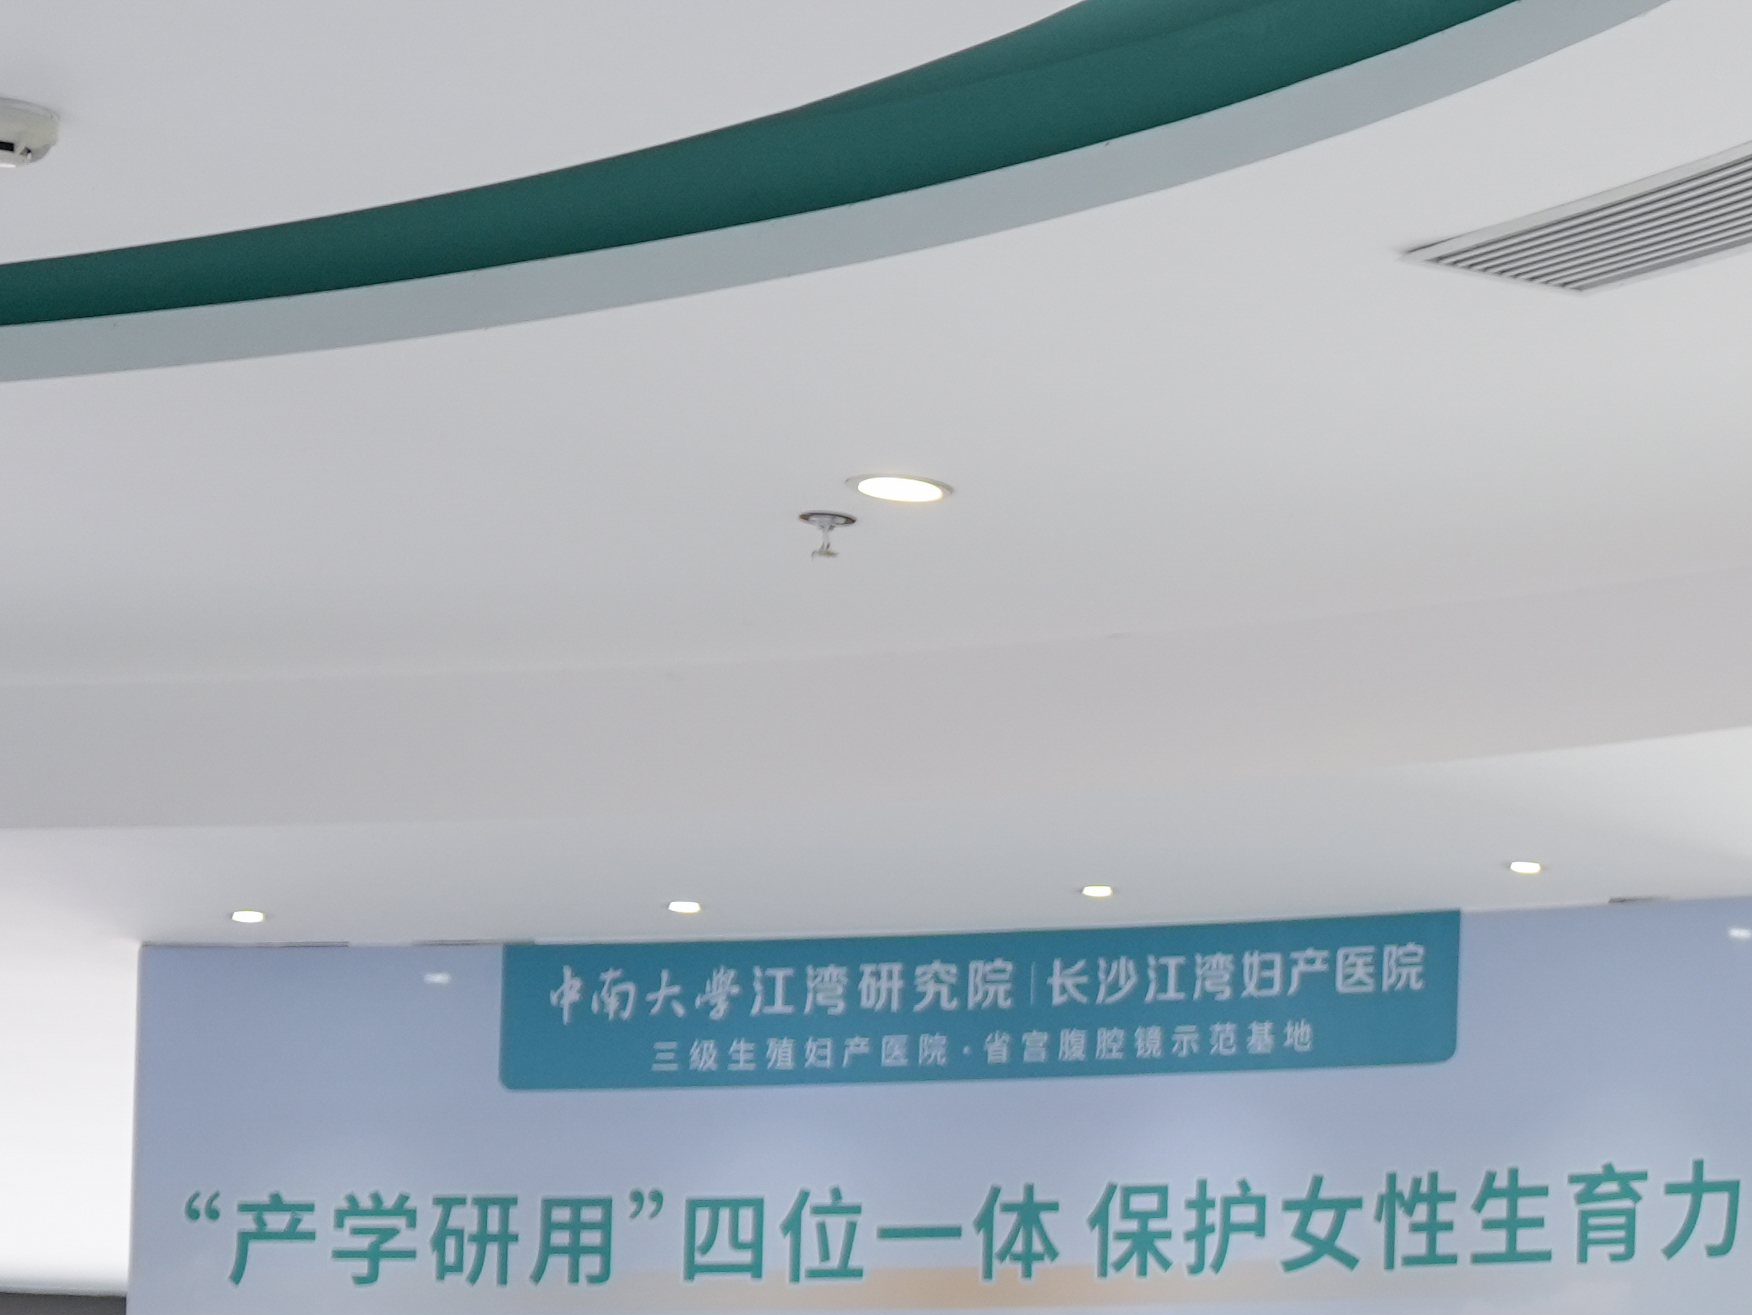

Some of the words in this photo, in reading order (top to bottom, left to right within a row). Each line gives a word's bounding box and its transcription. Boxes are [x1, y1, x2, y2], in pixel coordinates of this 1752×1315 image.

[1046, 941, 1427, 1006] 长沙江湾妇产医院
[1087, 1157, 1746, 1281] 保护女性生育力
